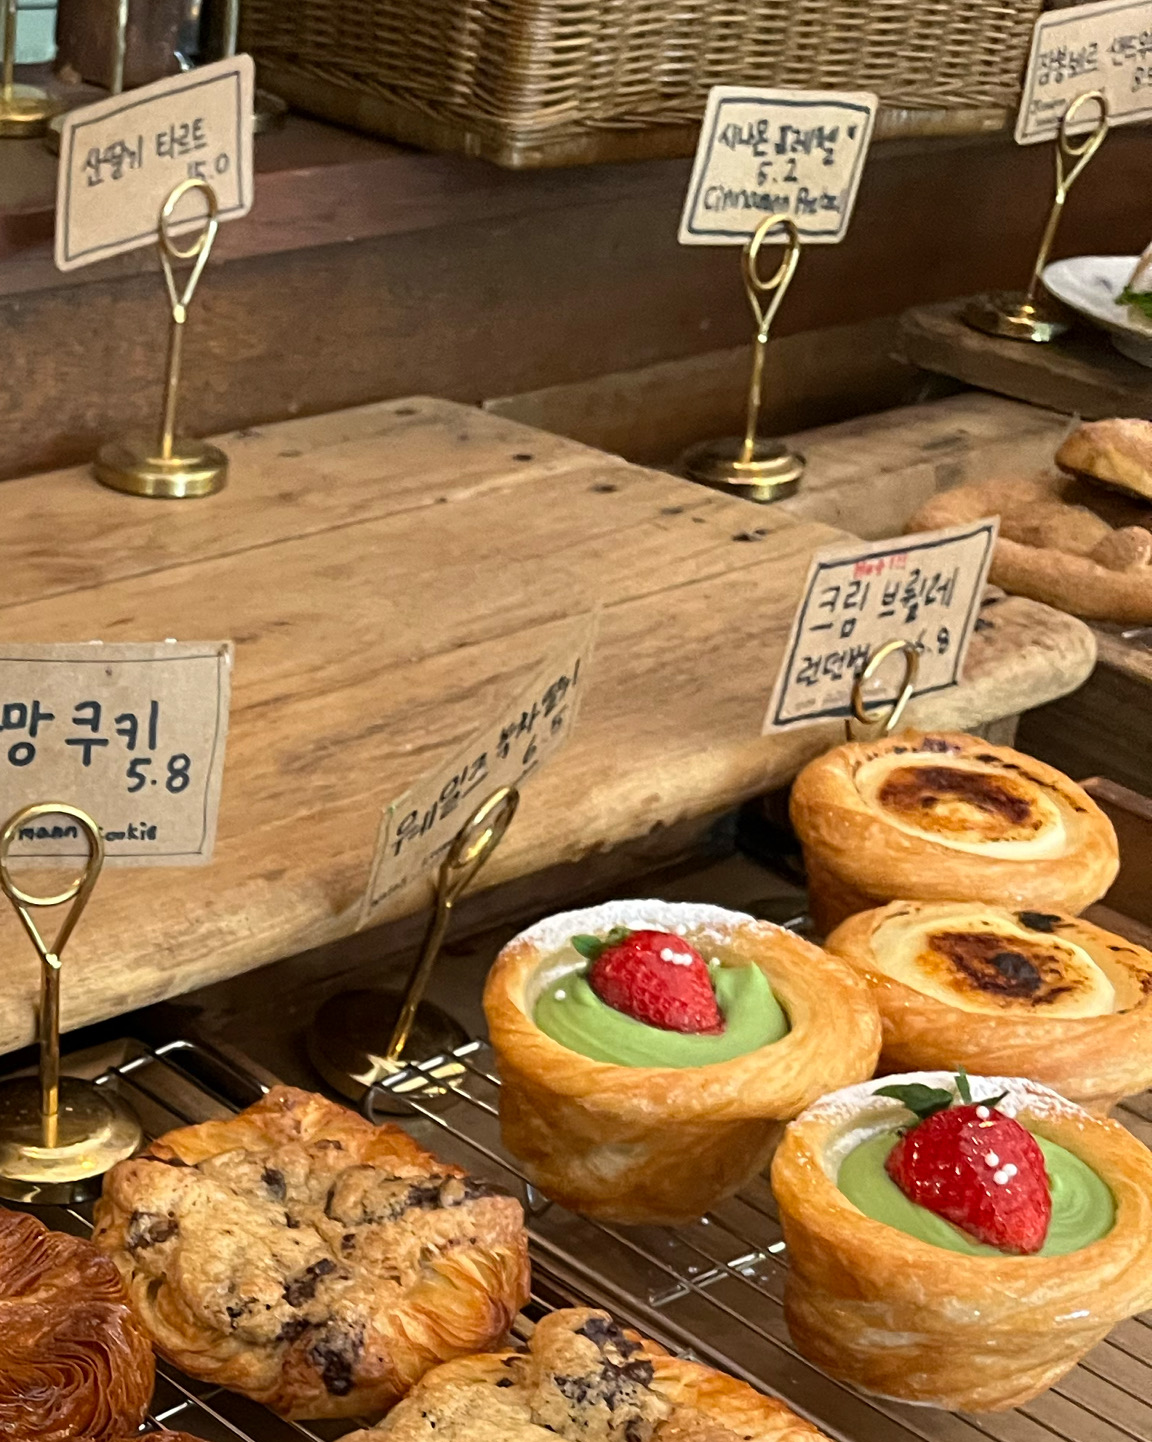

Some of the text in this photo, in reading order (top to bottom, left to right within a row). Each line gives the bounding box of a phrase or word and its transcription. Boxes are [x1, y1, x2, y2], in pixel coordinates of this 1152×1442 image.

[156, 117, 207, 158] 타르트
[719, 119, 768, 157] 시나몬
[810, 580, 870, 638] 크림
[65, 700, 159, 767] 쿠키
[126, 753, 191, 793] 5.8
